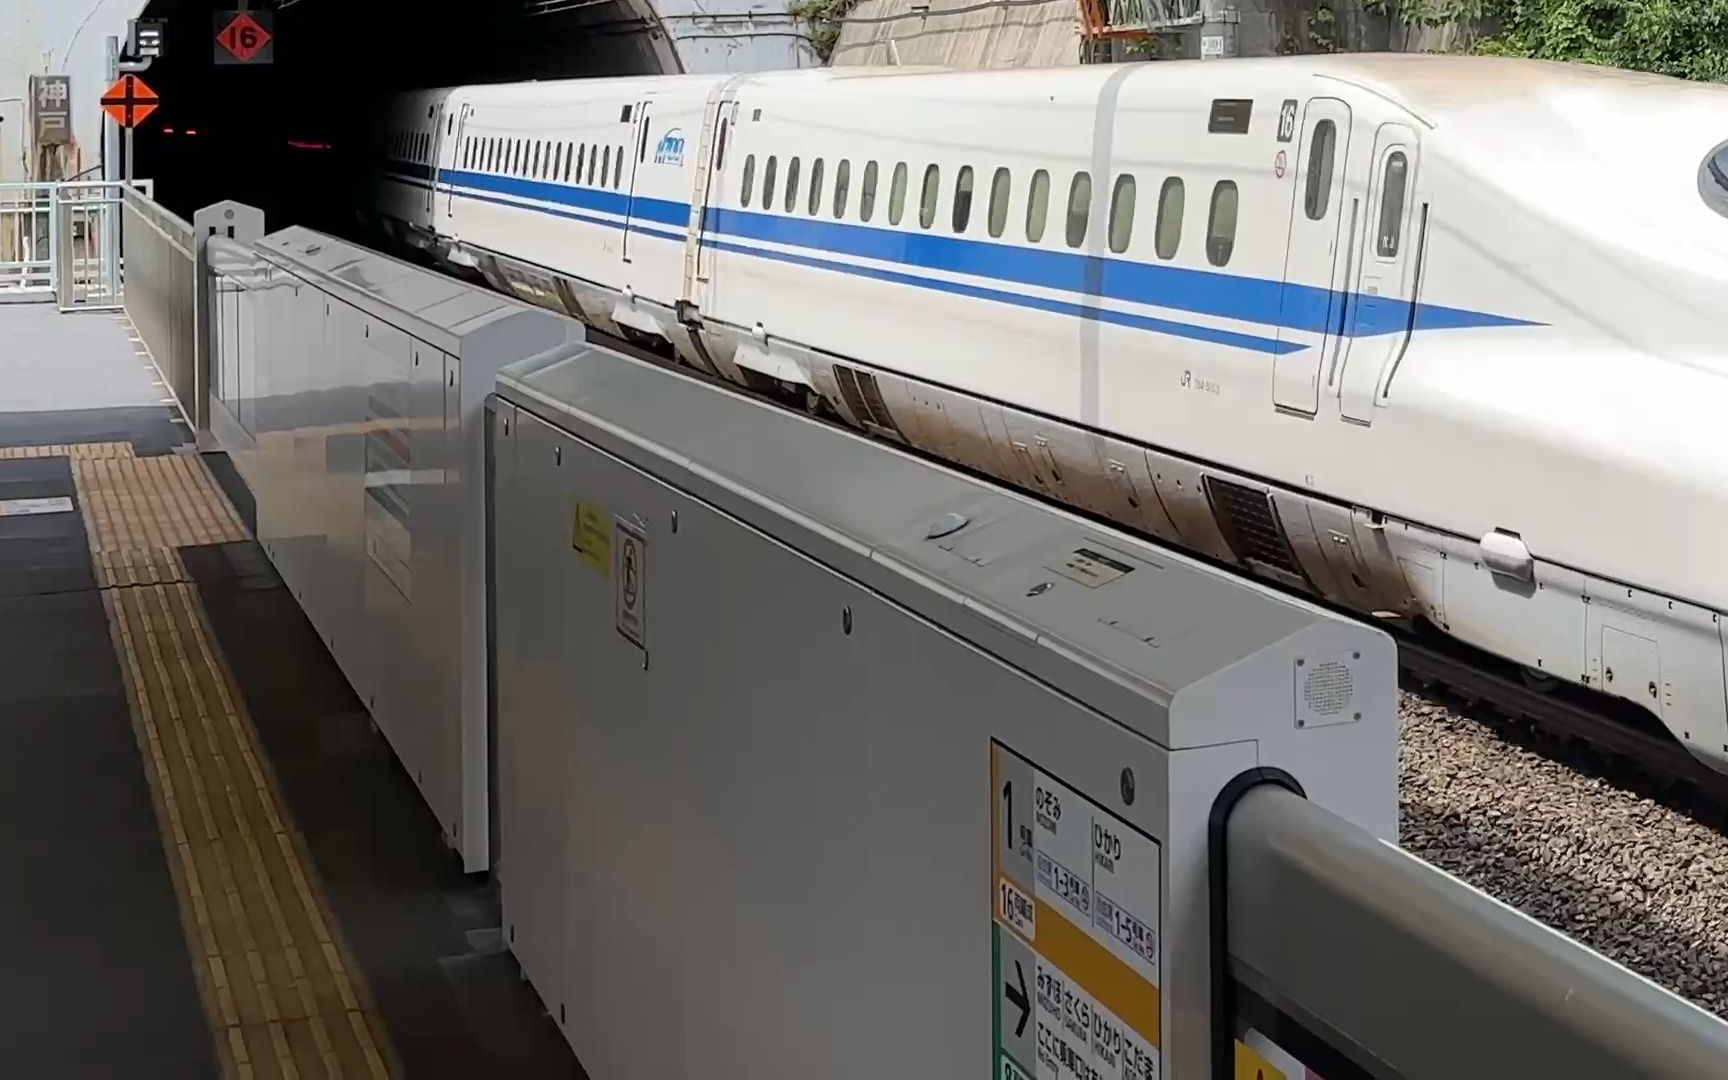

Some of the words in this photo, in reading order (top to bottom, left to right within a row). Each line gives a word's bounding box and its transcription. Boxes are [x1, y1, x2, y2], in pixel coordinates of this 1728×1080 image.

[229, 26, 257, 49] 16
[38, 79, 67, 142] 神戸
[1280, 105, 1295, 138] 16
[1180, 370, 1192, 389] JR
[1036, 787, 1061, 821] のぞみ
[1095, 824, 1121, 860] ひかり
[1037, 965, 1061, 1004] みずほ
[1065, 991, 1090, 1028] さくら
[1095, 1012, 1121, 1054] ひかり
[1125, 1038, 1154, 1079] こだま
